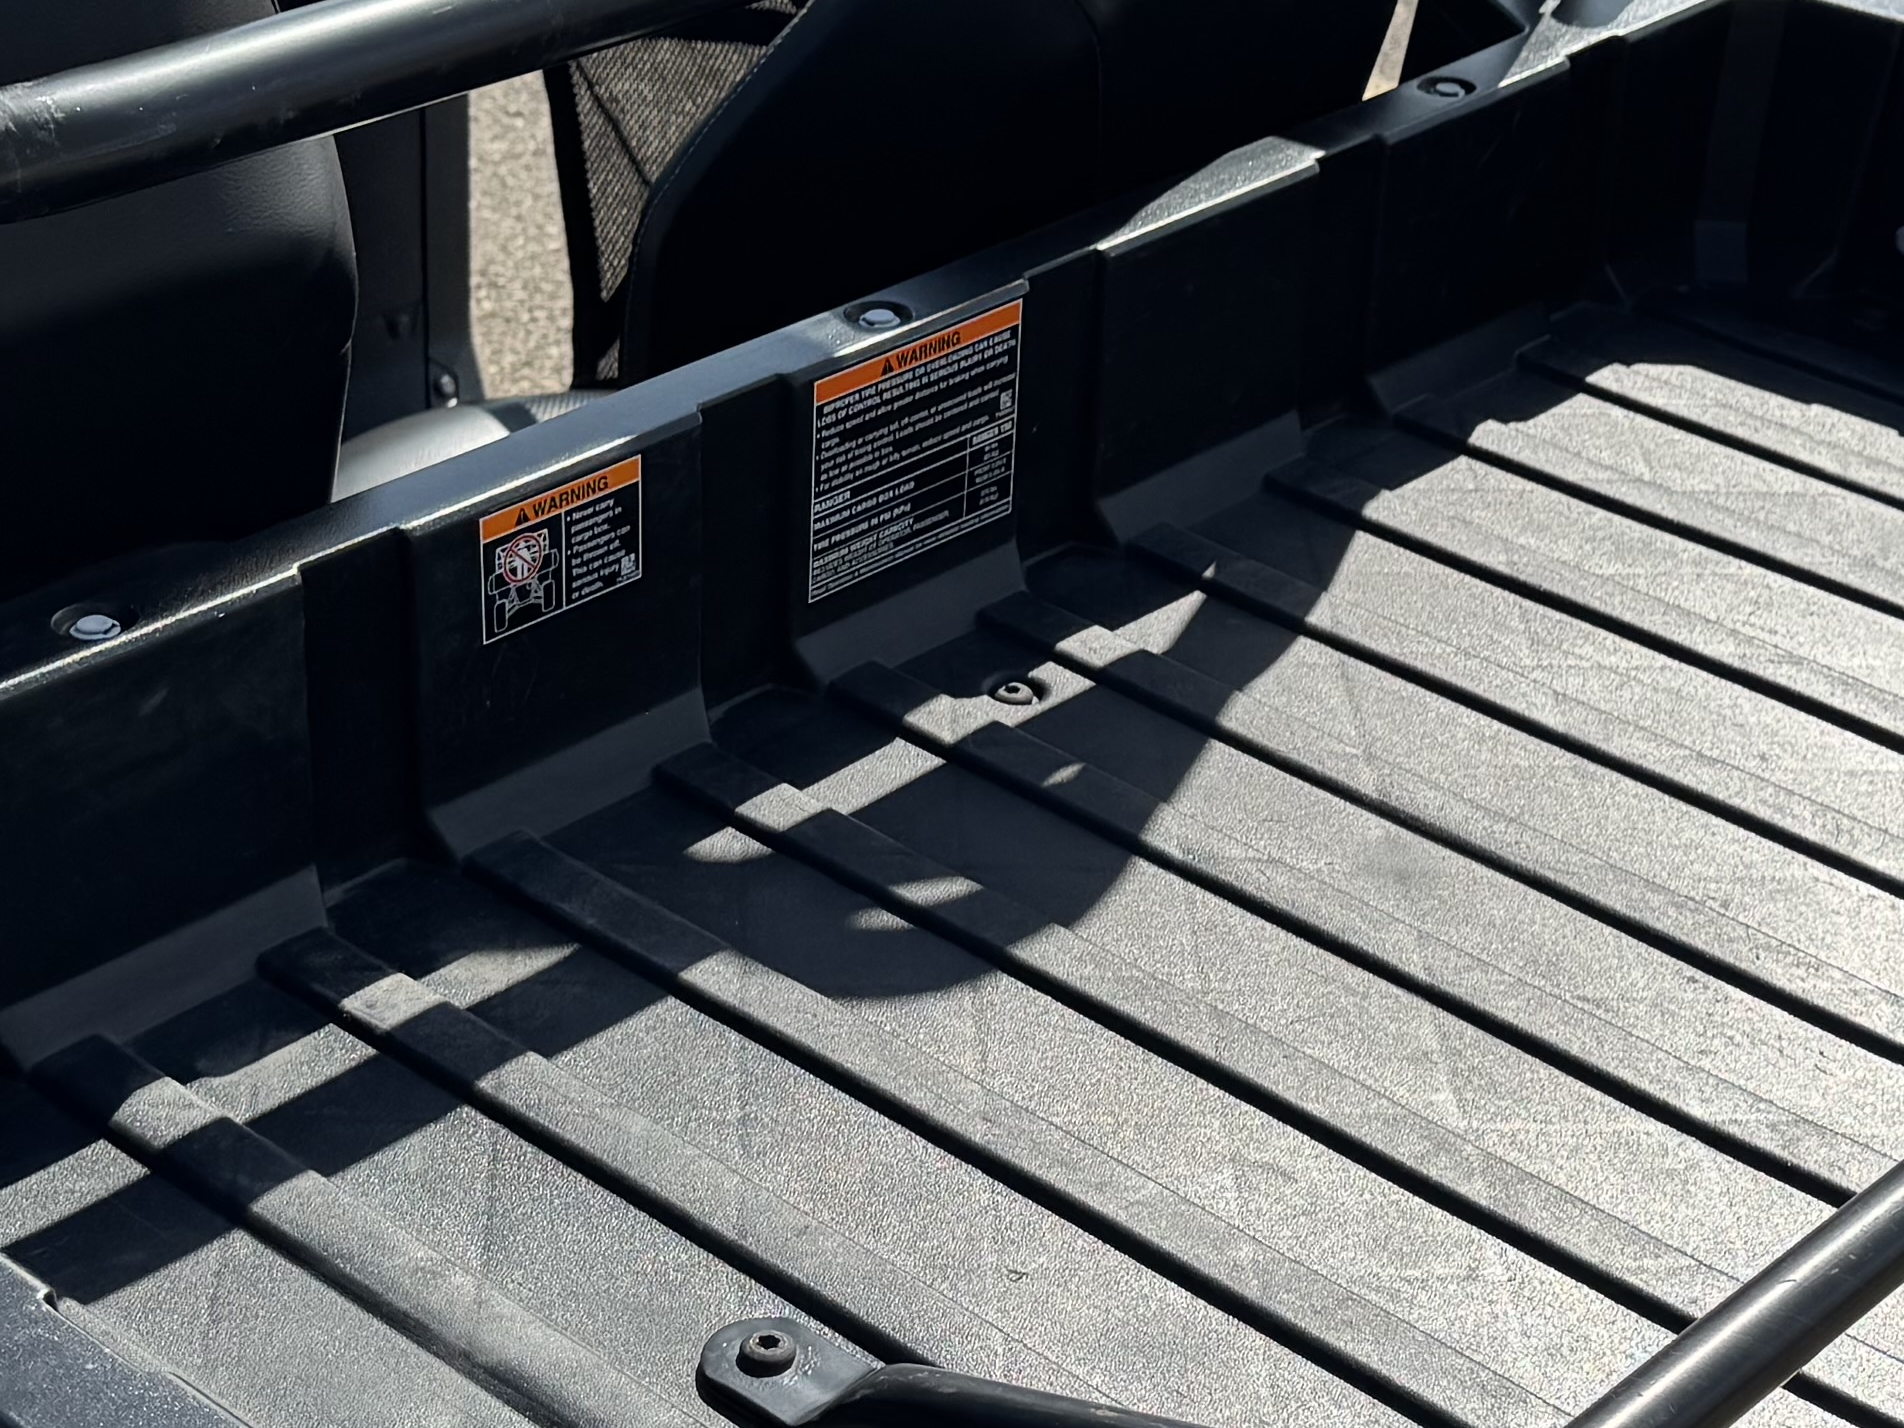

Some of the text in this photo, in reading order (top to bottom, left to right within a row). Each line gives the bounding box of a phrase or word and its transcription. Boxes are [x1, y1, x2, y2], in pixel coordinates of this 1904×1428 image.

[896, 331, 960, 367] WARNING
[533, 476, 608, 517] WARNING
[813, 490, 850, 513] RANGER
[894, 481, 914, 495] LOAD
